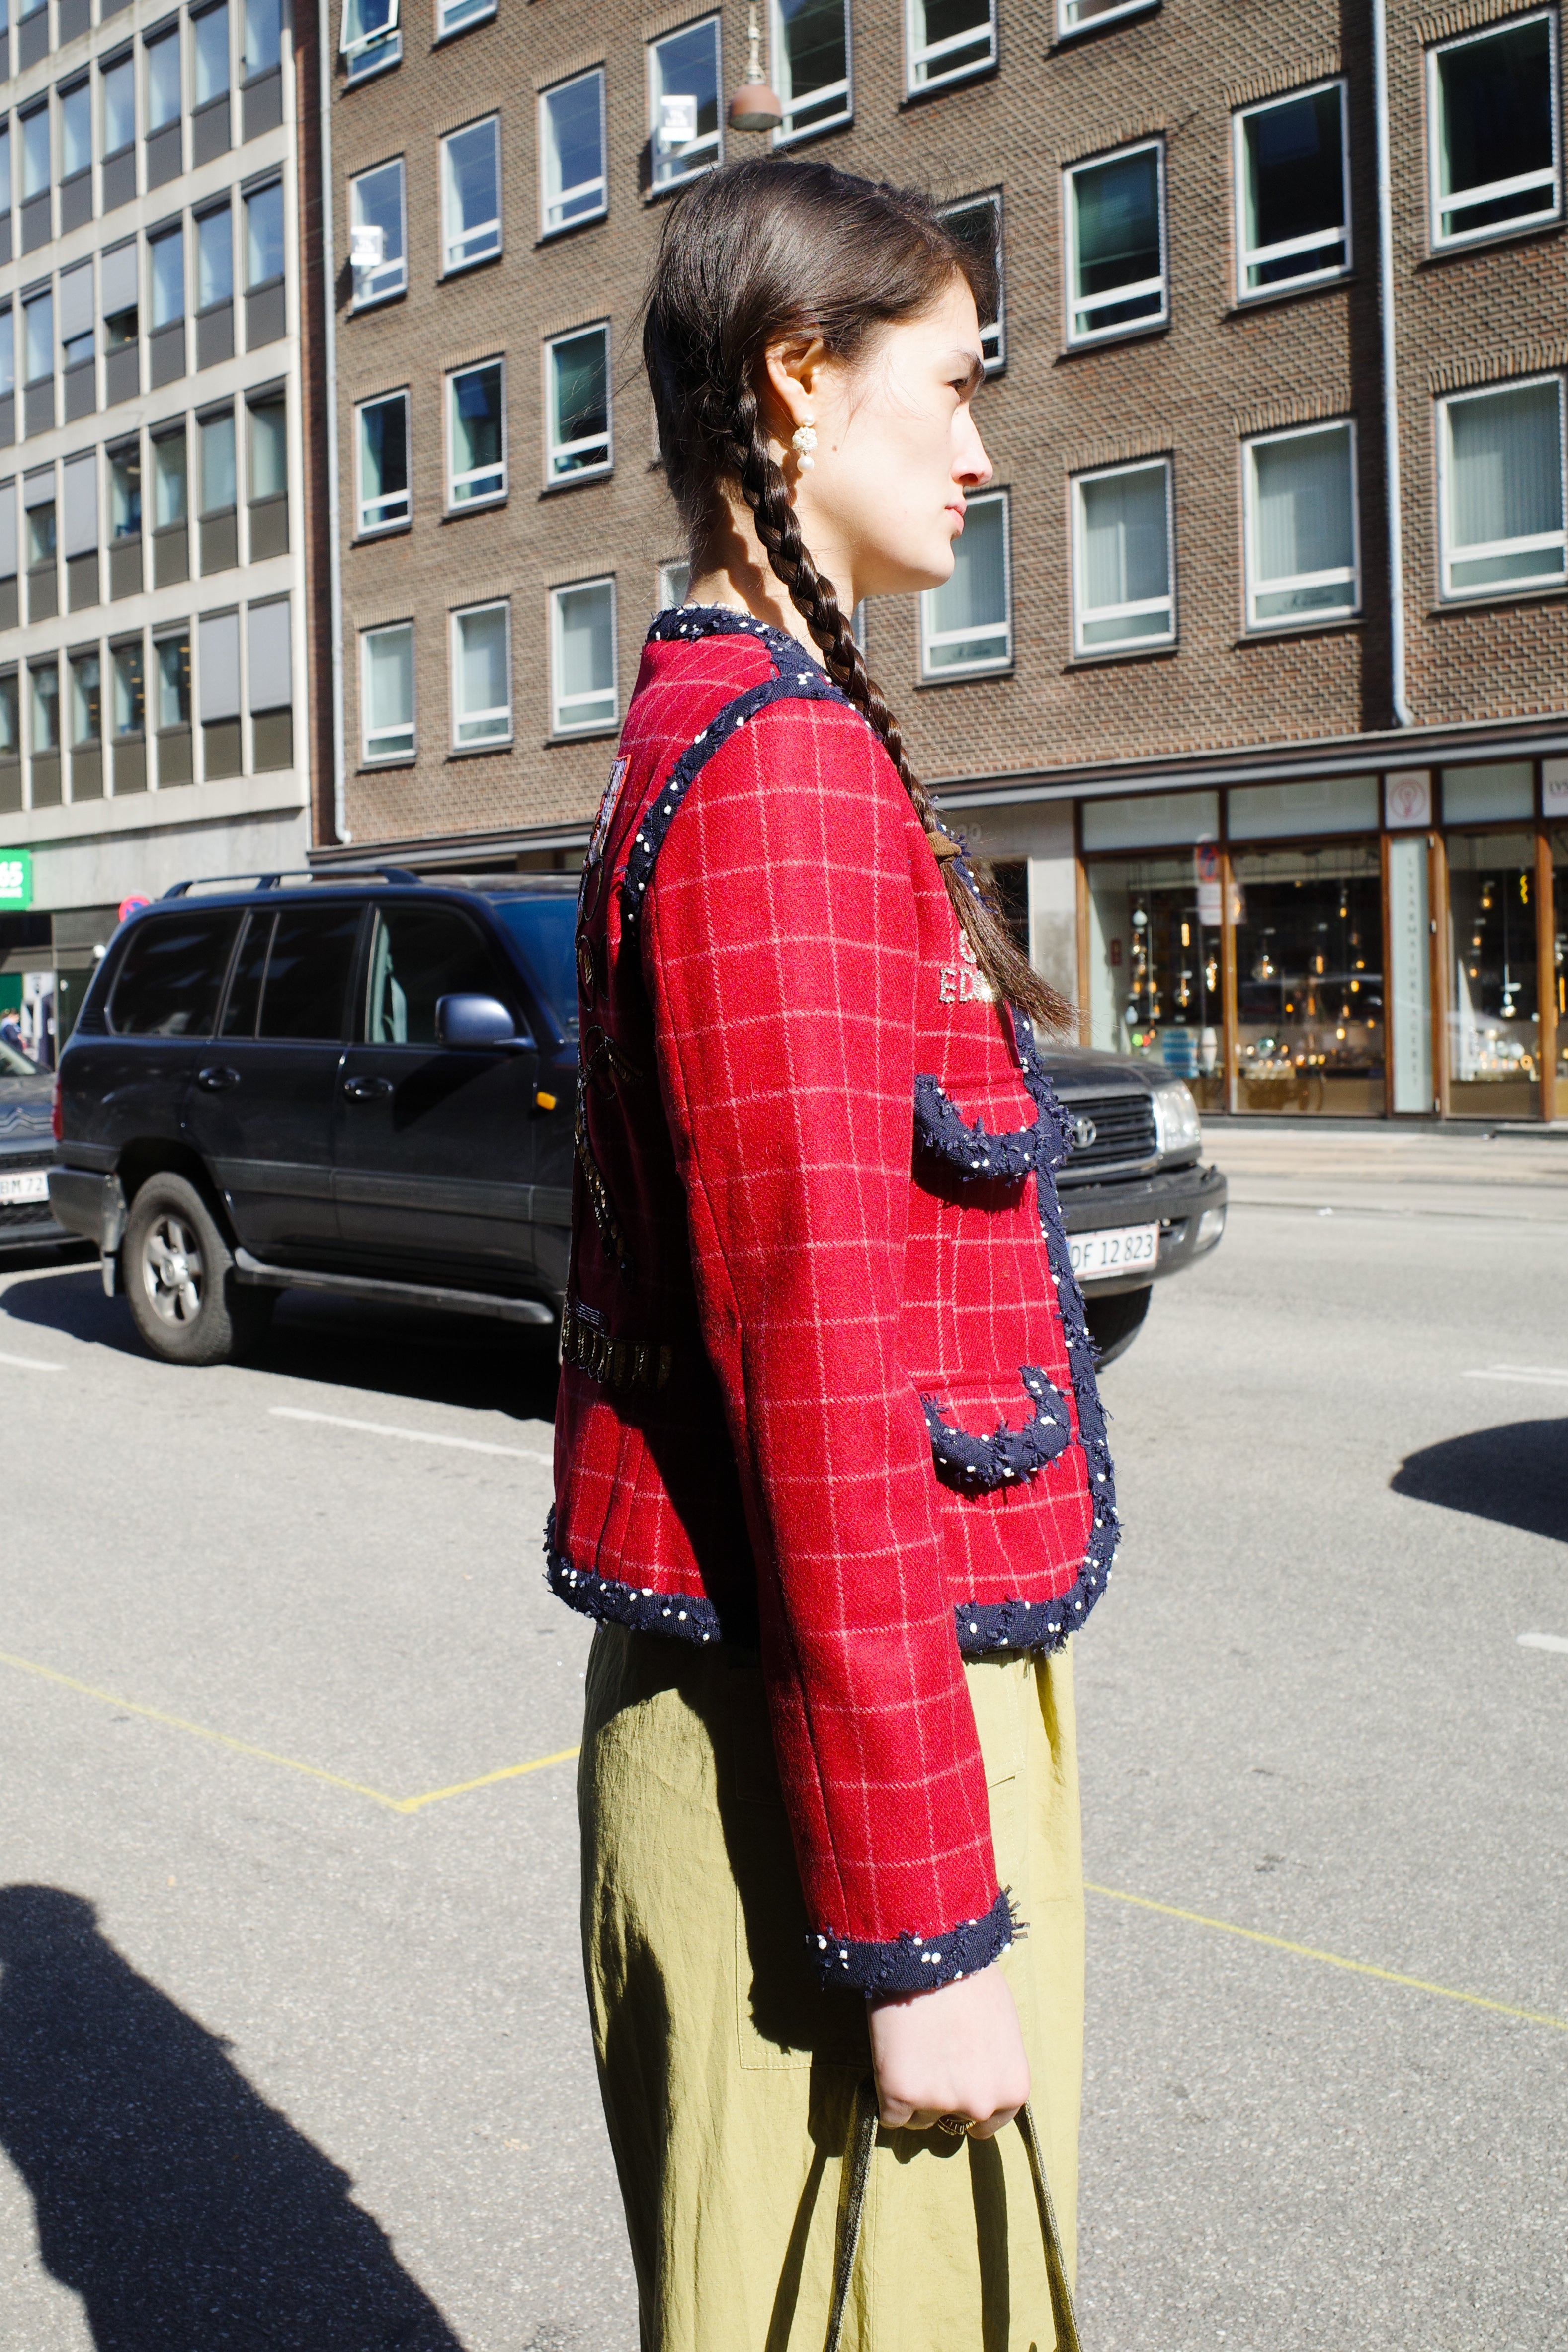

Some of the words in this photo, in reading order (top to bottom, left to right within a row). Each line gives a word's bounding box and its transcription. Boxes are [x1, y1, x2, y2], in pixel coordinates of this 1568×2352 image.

[26, 1176, 42, 1192] 72
[1101, 1240, 1119, 1266] 12
[1124, 1234, 1153, 1261] 823
